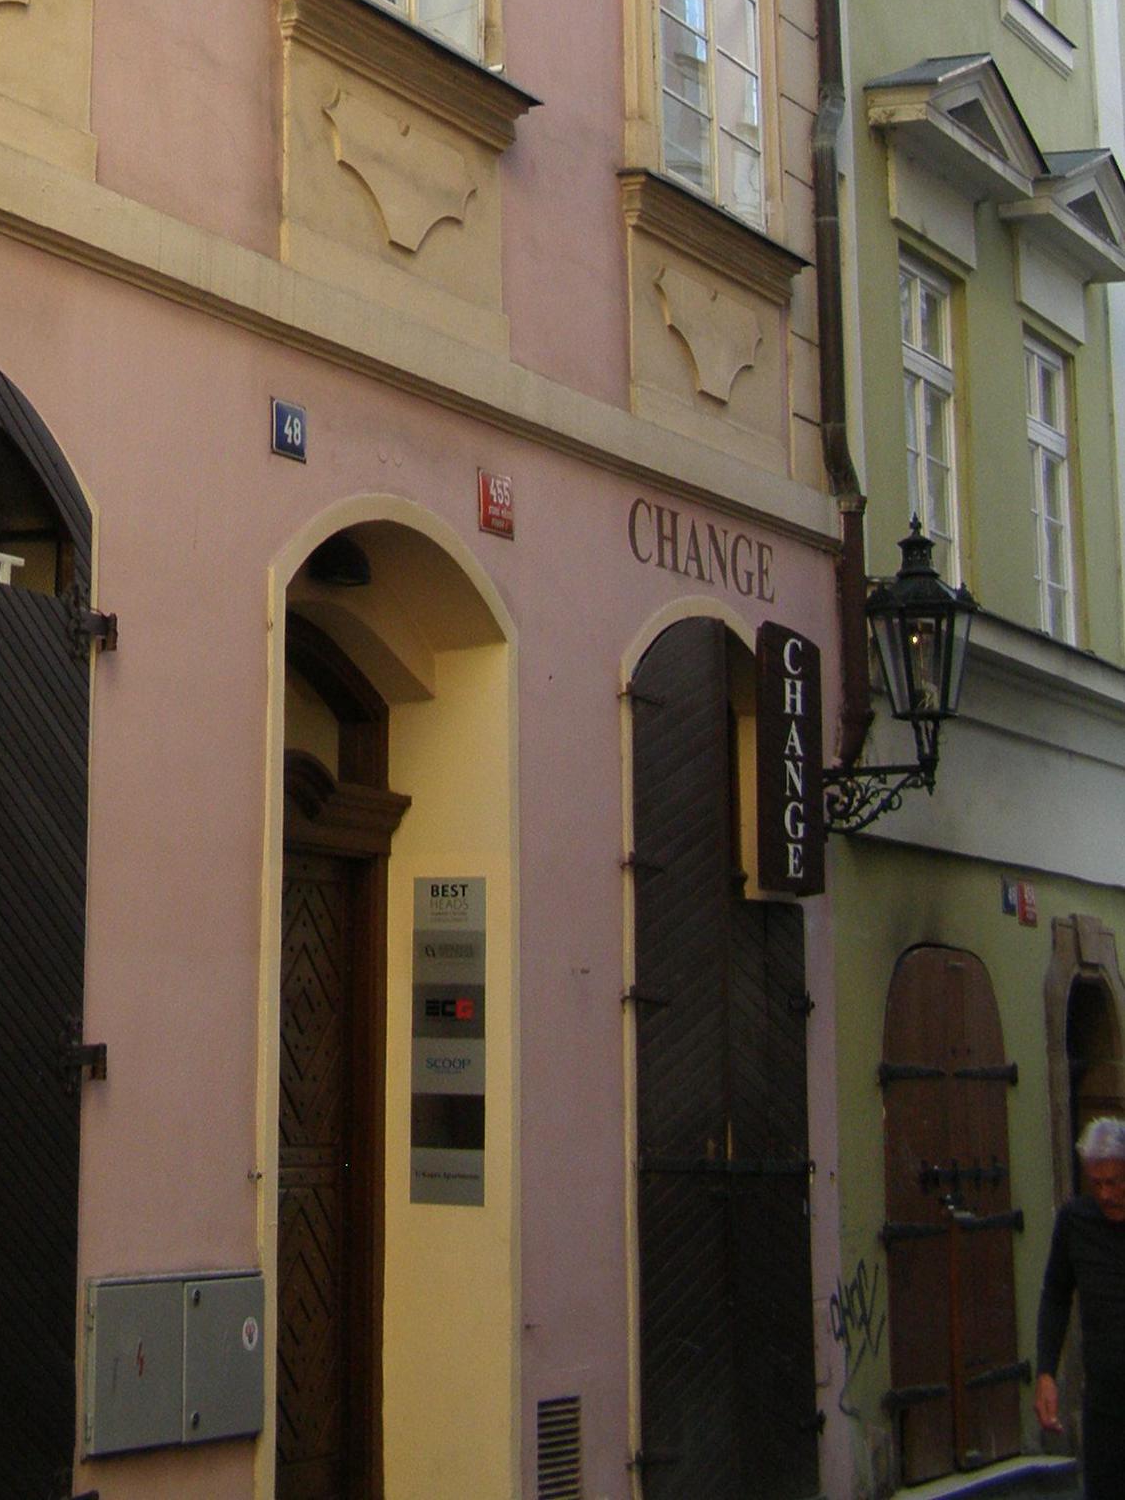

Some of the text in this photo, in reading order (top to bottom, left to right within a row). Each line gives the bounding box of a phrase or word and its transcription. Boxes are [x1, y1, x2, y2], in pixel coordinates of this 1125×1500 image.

[283, 414, 302, 446] 48
[489, 475, 511, 508] 455
[627, 497, 774, 603] CHANGE
[782, 637, 805, 879] CHANGE
[429, 898, 469, 911] HEADS
[430, 883, 469, 898] BEST
[425, 1057, 472, 1070] SCOOP
